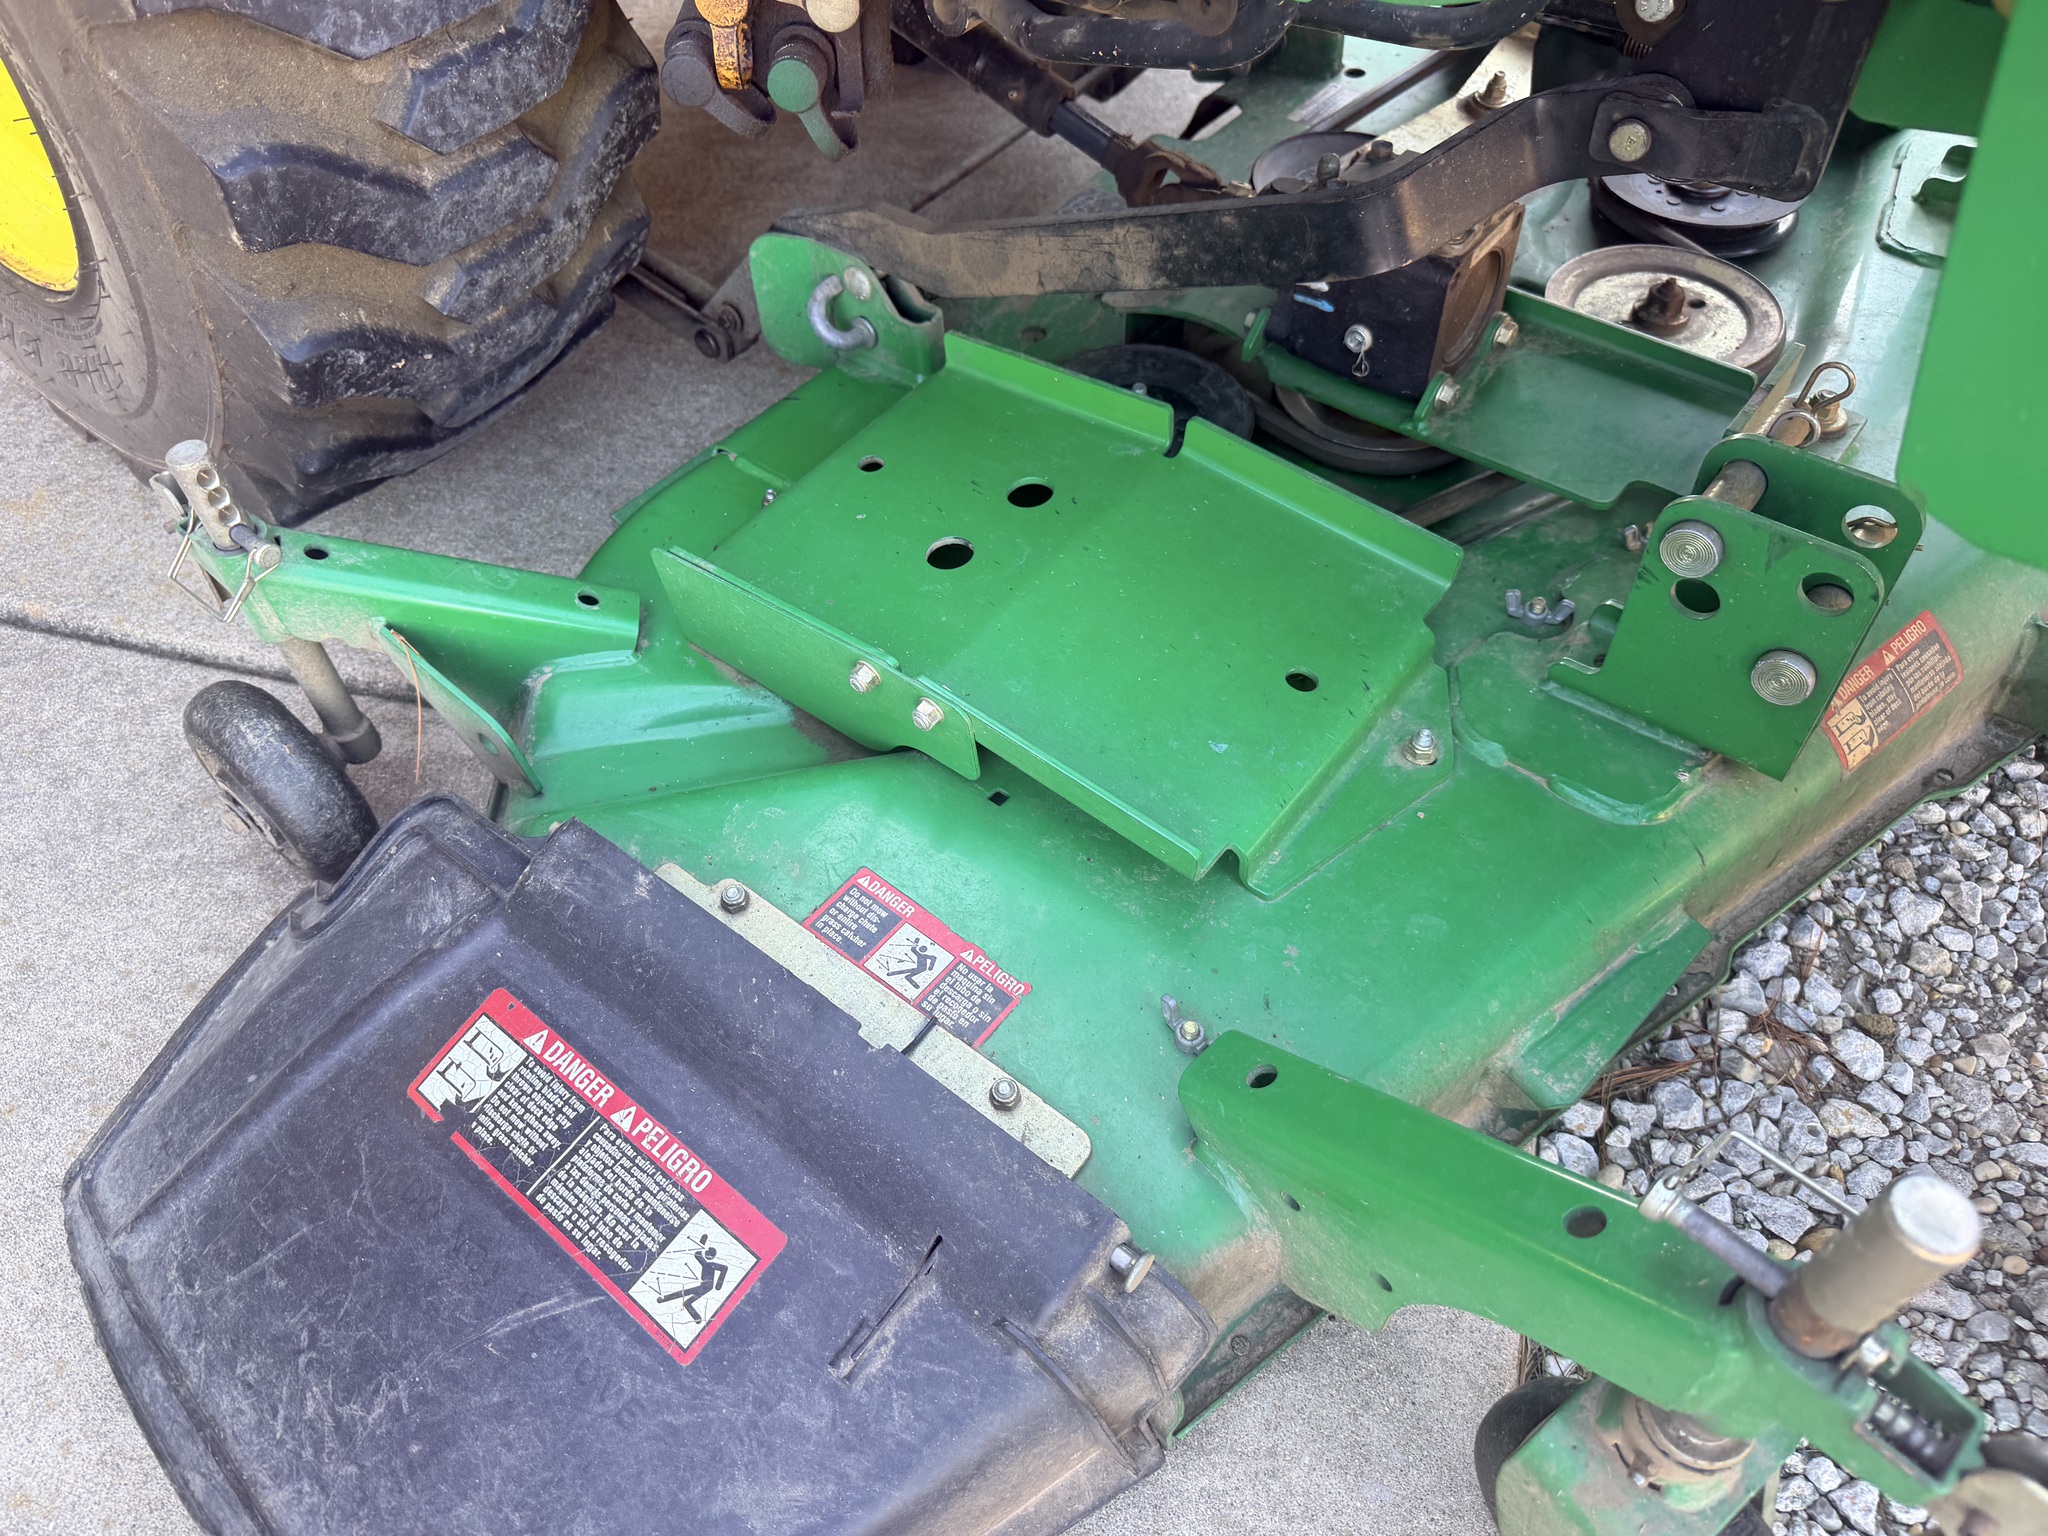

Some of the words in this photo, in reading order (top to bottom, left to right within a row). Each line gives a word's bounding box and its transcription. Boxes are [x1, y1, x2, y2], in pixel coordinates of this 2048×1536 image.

[1890, 620, 1926, 655] PELIGRO
[1895, 659, 1908, 671] Para
[1907, 648, 1920, 662] evitar
[1900, 660, 1920, 679] lesiones
[1919, 643, 1939, 663] causadas
[1837, 665, 1874, 699] DANGER
[1864, 698, 1877, 710] from
[1875, 683, 1894, 701] rotating
[1866, 682, 1880, 697] avoid
[1886, 691, 1898, 705] stay
[1873, 712, 1886, 725] clear
[836, 901, 859, 920] charge
[858, 917, 877, 933] chute
[843, 895, 868, 914] without
[866, 912, 880, 922] dis-
[849, 887, 860, 898] Do
[859, 895, 872, 906] not
[870, 904, 888, 917] mow
[868, 881, 914, 917] DANGER
[820, 914, 841, 930] grass
[840, 928, 866, 947] catcher
[821, 926, 842, 944] place.
[837, 914, 857, 930] entire
[945, 976, 955, 985] el
[953, 981, 971, 997] tubo
[970, 994, 981, 1004] de
[956, 963, 968, 974] No
[968, 972, 985, 986] usar
[984, 983, 993, 993] la
[972, 955, 1024, 995] PELIGRO
[921, 1001, 933, 1011] su
[933, 1007, 954, 1028] lugar.
[927, 994, 938, 1004] de
[936, 1002, 959, 1019] pasto
[958, 1017, 969, 1028] en
[933, 988, 943, 997] el
[942, 995, 979, 1023] recogedor
[937, 982, 972, 1009] descarga
[970, 1006, 979, 1014] o
[978, 1011, 991, 1023] sin
[982, 993, 995, 1004] sin
[518, 1065, 542, 1090] rotating
[541, 1085, 563, 1107] blades
[562, 1105, 577, 1118] and
[525, 1056, 535, 1068] To
[533, 1065, 553, 1083] avoid
[569, 1096, 585, 1113] from
[543, 1041, 614, 1107] DANGER
[504, 1081, 521, 1097] clear
[520, 1095, 530, 1104] of
[527, 1101, 543, 1117] deck
[541, 1115, 558, 1131] edge
[511, 1072, 532, 1094] thrown
[531, 1092, 555, 1116] objects,
[556, 1114, 571, 1129] stay
[473, 1125, 493, 1145] place.
[490, 1095, 500, 1106] Do
[498, 1104, 511, 1116] not
[509, 1114, 526, 1129] mow
[524, 1127, 548, 1151] without
[497, 1088, 511, 1101] and
[508, 1098, 525, 1115] keep
[523, 1113, 544, 1132] others
[543, 1130, 561, 1150] away.
[477, 1113, 494, 1130] ntire
[492, 1128, 510, 1146] grass
[509, 1144, 534, 1166] catcher
[528, 1145, 537, 1155] or
[632, 1118, 711, 1192] PELIGRO
[593, 1132, 622, 1159] causadas
[618, 1157, 633, 1168] por
[631, 1166, 659, 1193] cuchillas
[656, 1191, 689, 1220] giratorias
[599, 1123, 616, 1140] Para
[615, 1138, 636, 1158] evitar
[635, 1156, 655, 1174] sufrir
[654, 1171, 684, 1201] lesiones
[570, 1155, 605, 1187] plataforma
[603, 1184, 614, 1195] de
[612, 1192, 630, 1210] corte
[627, 1206, 635, 1215] y
[633, 1212, 666, 1242] mantener
[579, 1147, 604, 1171] alejado
[603, 1169, 617, 1185] del
[614, 1178, 635, 1201] borde
[634, 1198, 644, 1208] de
[643, 1205, 653, 1216] la
[584, 1139, 592, 1147] y
[590, 1144, 614, 1166] objetos
[613, 1163, 641, 1194] lanzados,
[642, 1191, 680, 1227] mantenerse
[550, 1178, 578, 1206] máquina
[576, 1203, 589, 1217] sin
[588, 1214, 599, 1224] el
[596, 1220, 613, 1239] tubo
[612, 1237, 623, 1248] de
[557, 1170, 568, 1181] de
[566, 1177, 575, 1188] la
[573, 1186, 602, 1218] máquina.
[604, 1213, 616, 1227] No
[615, 1224, 632, 1241] usar
[630, 1237, 639, 1249] la
[564, 1162, 571, 1170] a
[569, 1166, 581, 1179] las
[599, 1196, 630, 1225] personas
[629, 1223, 659, 1252] alejadas
[536, 1193, 546, 1204] de
[543, 1202, 564, 1221] pasto
[562, 1219, 573, 1230] en
[571, 1228, 582, 1239] su
[581, 1235, 601, 1259] lugar.
[543, 1186, 572, 1215] descarga
[577, 1218, 590, 1231] sin
[588, 1229, 599, 1239] el
[596, 1237, 631, 1271] recogedor
